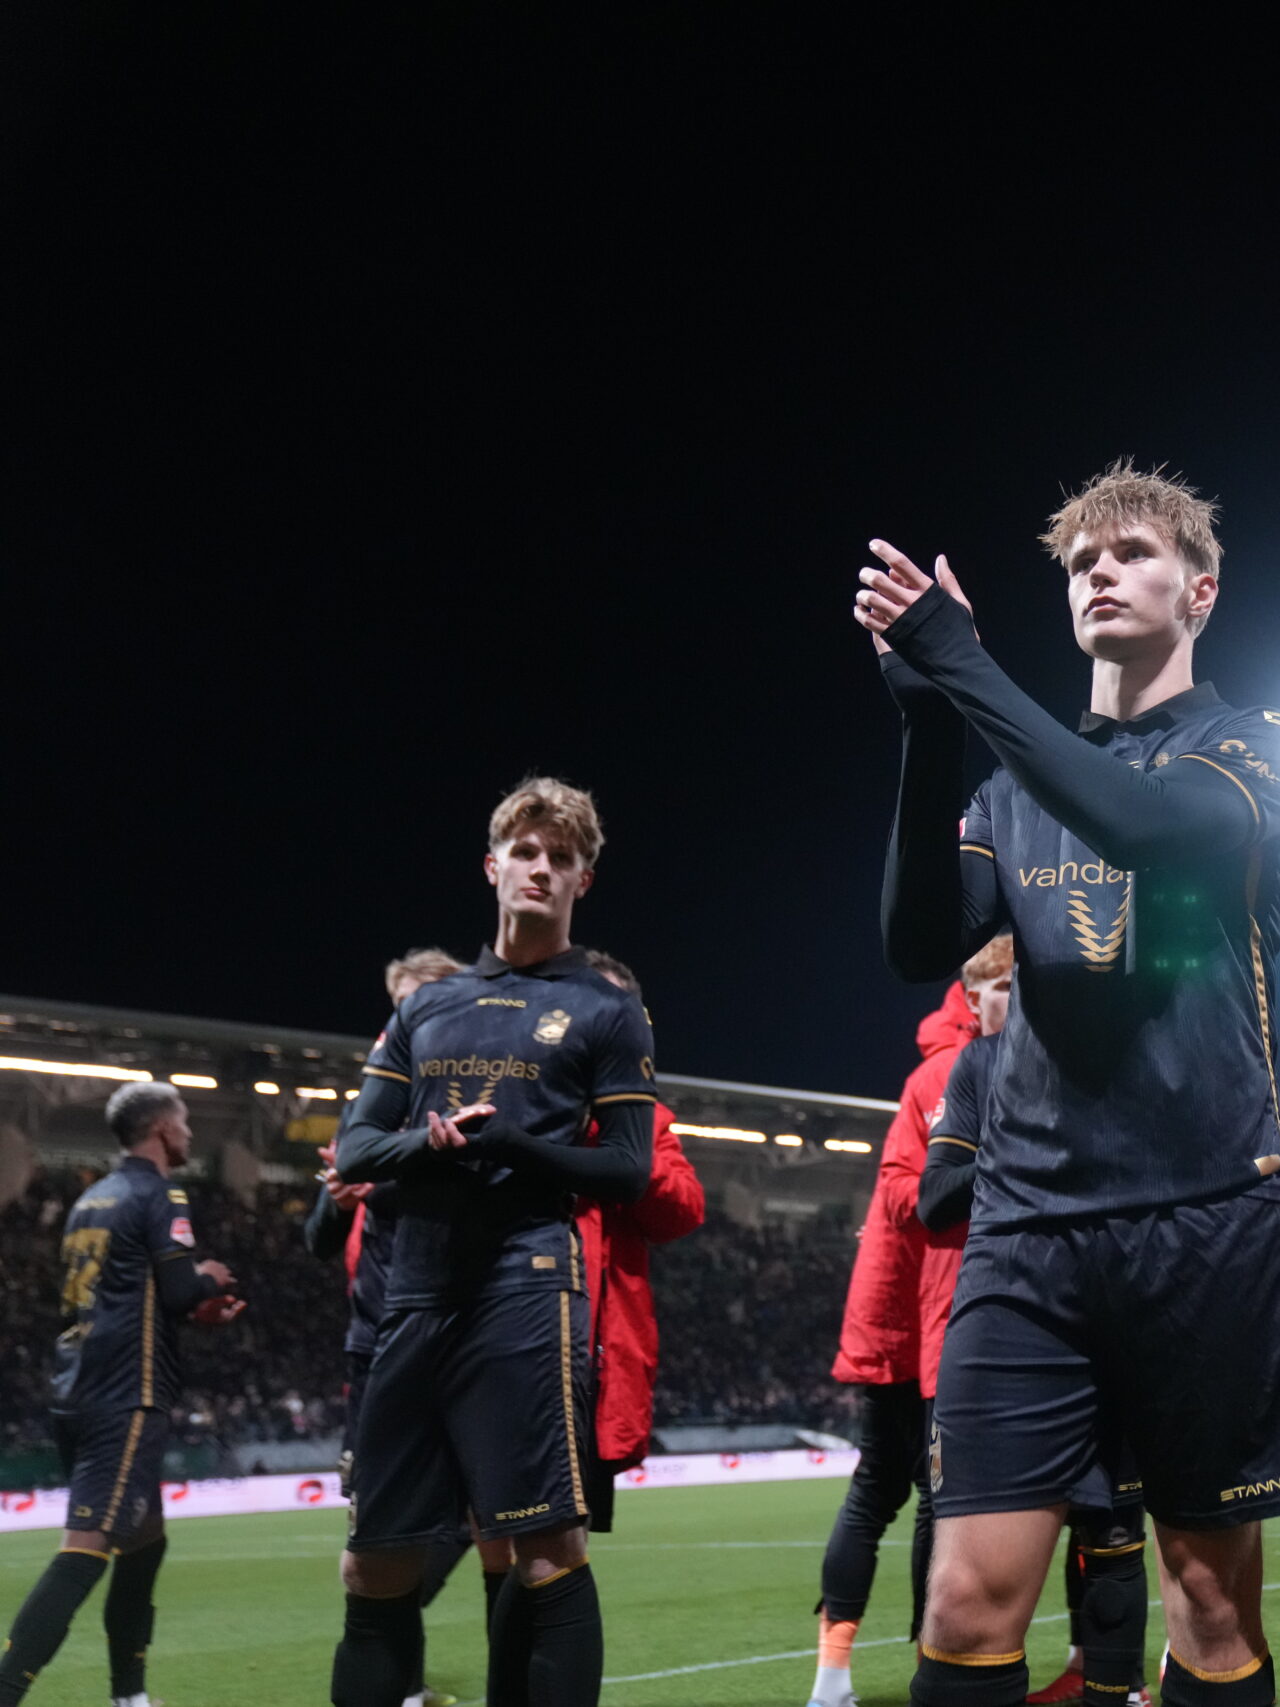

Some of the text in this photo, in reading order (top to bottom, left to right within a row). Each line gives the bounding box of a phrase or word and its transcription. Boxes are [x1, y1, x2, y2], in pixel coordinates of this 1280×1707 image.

[477, 997, 527, 1008] STANNO
[418, 1054, 541, 1081] vandaglas
[495, 1503, 550, 1521] STANNO
